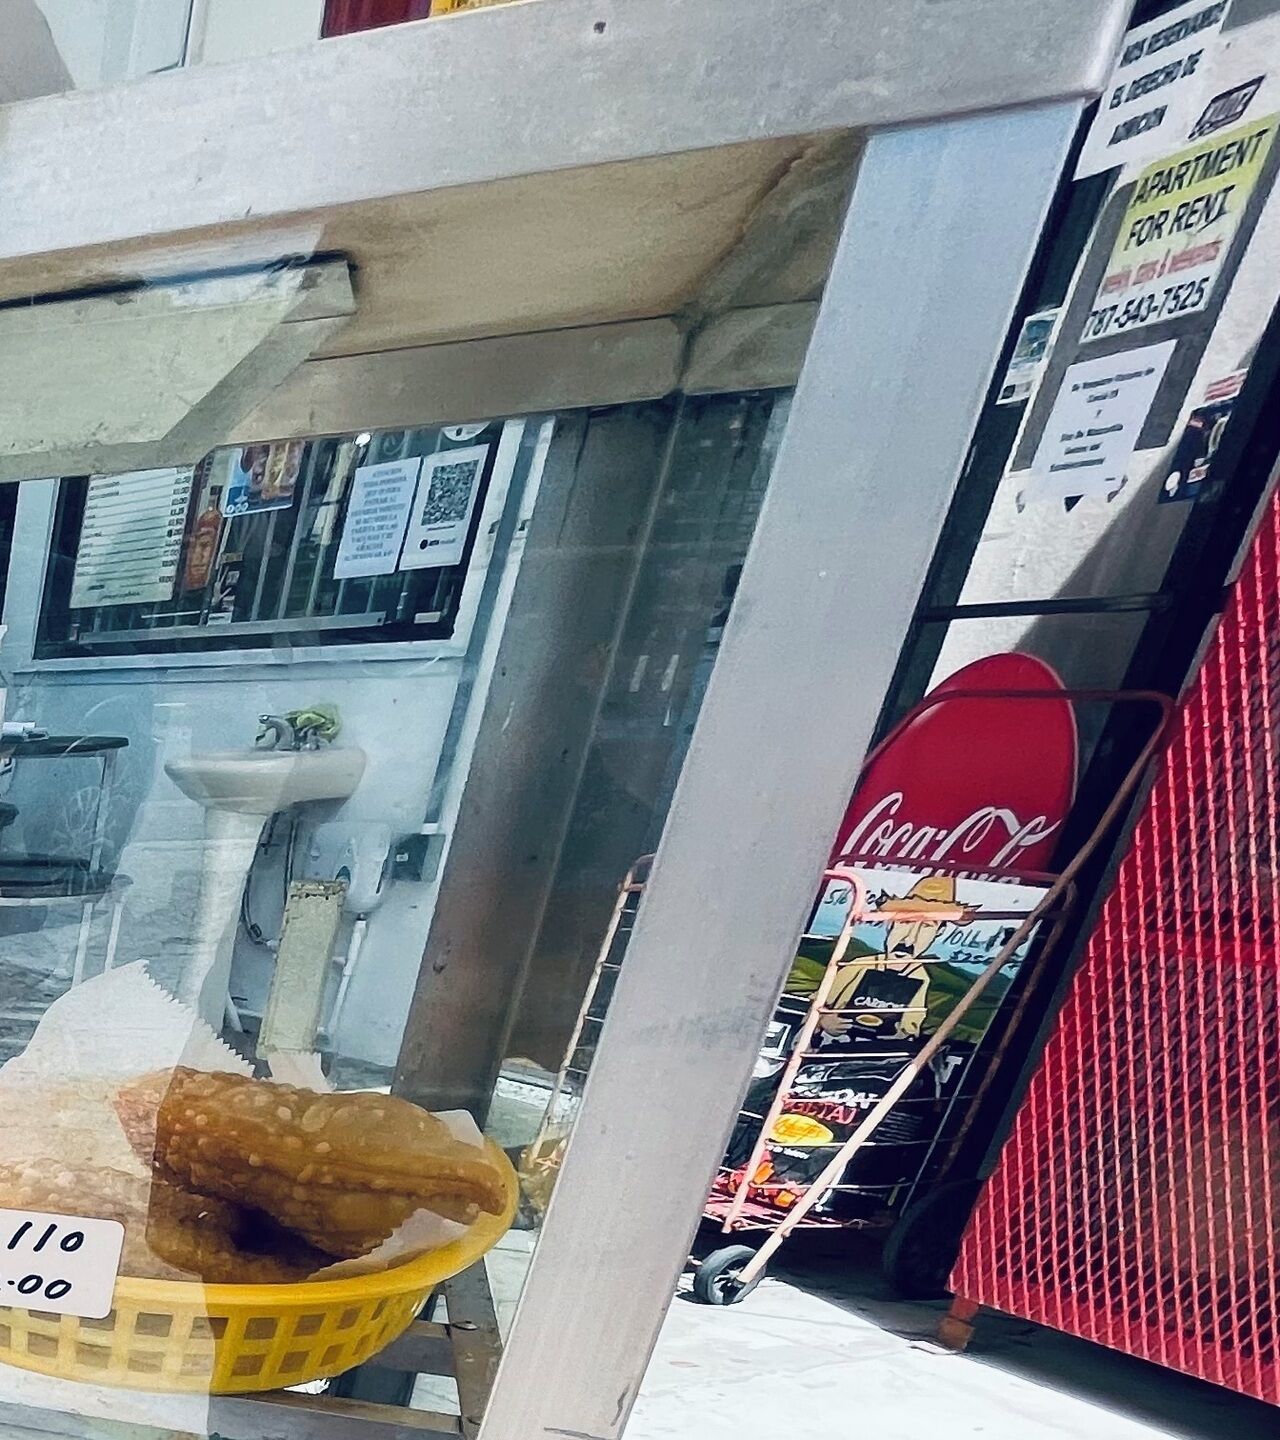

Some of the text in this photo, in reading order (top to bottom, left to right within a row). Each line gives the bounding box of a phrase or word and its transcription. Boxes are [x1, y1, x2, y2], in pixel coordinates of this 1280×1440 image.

[1131, 128, 1270, 208] APARTMENT
[1124, 184, 1236, 251] FOR RENT
